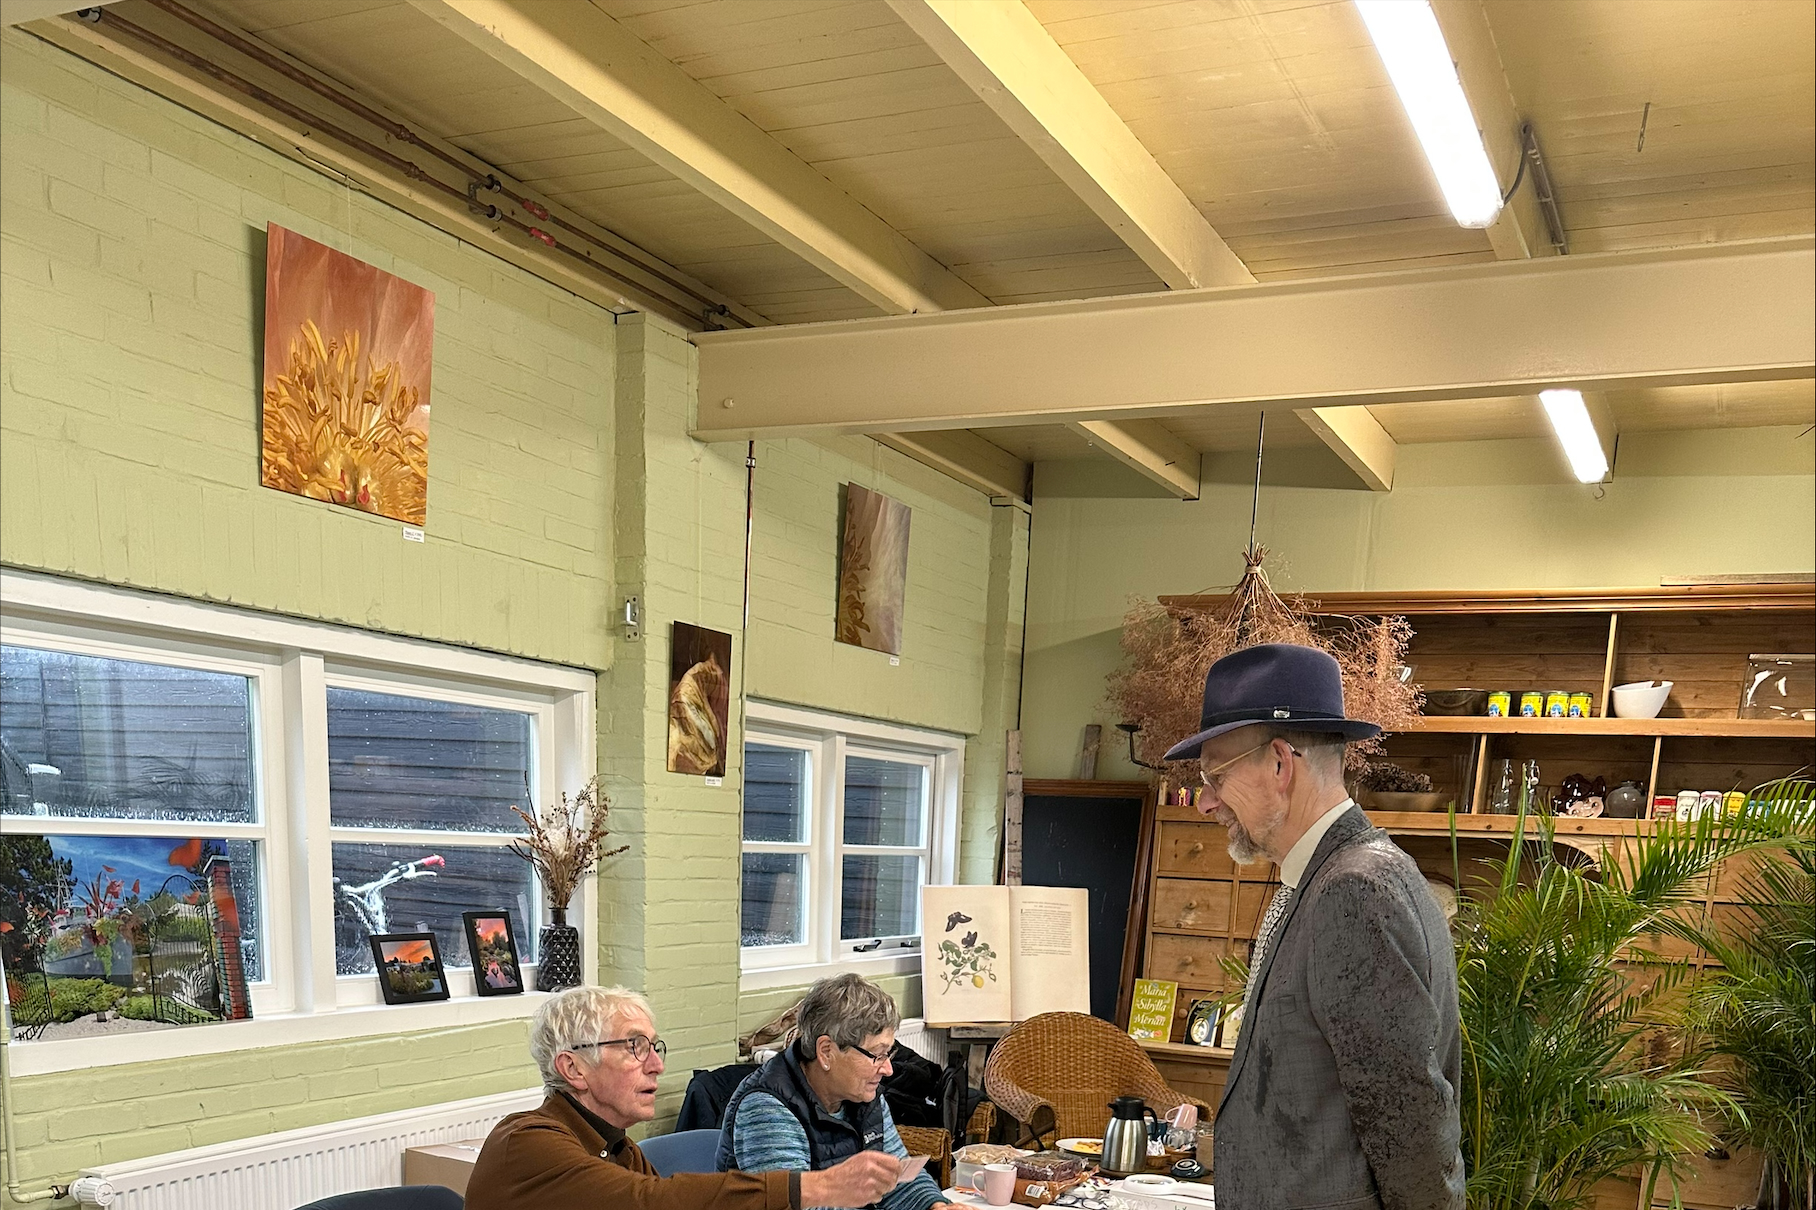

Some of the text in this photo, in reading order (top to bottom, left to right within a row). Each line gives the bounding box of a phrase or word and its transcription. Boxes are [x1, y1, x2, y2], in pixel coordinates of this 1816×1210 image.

[1140, 984, 1167, 997] Maria
[1137, 998, 1167, 1014] Sibylla
[1134, 1013, 1165, 1026] Merian
